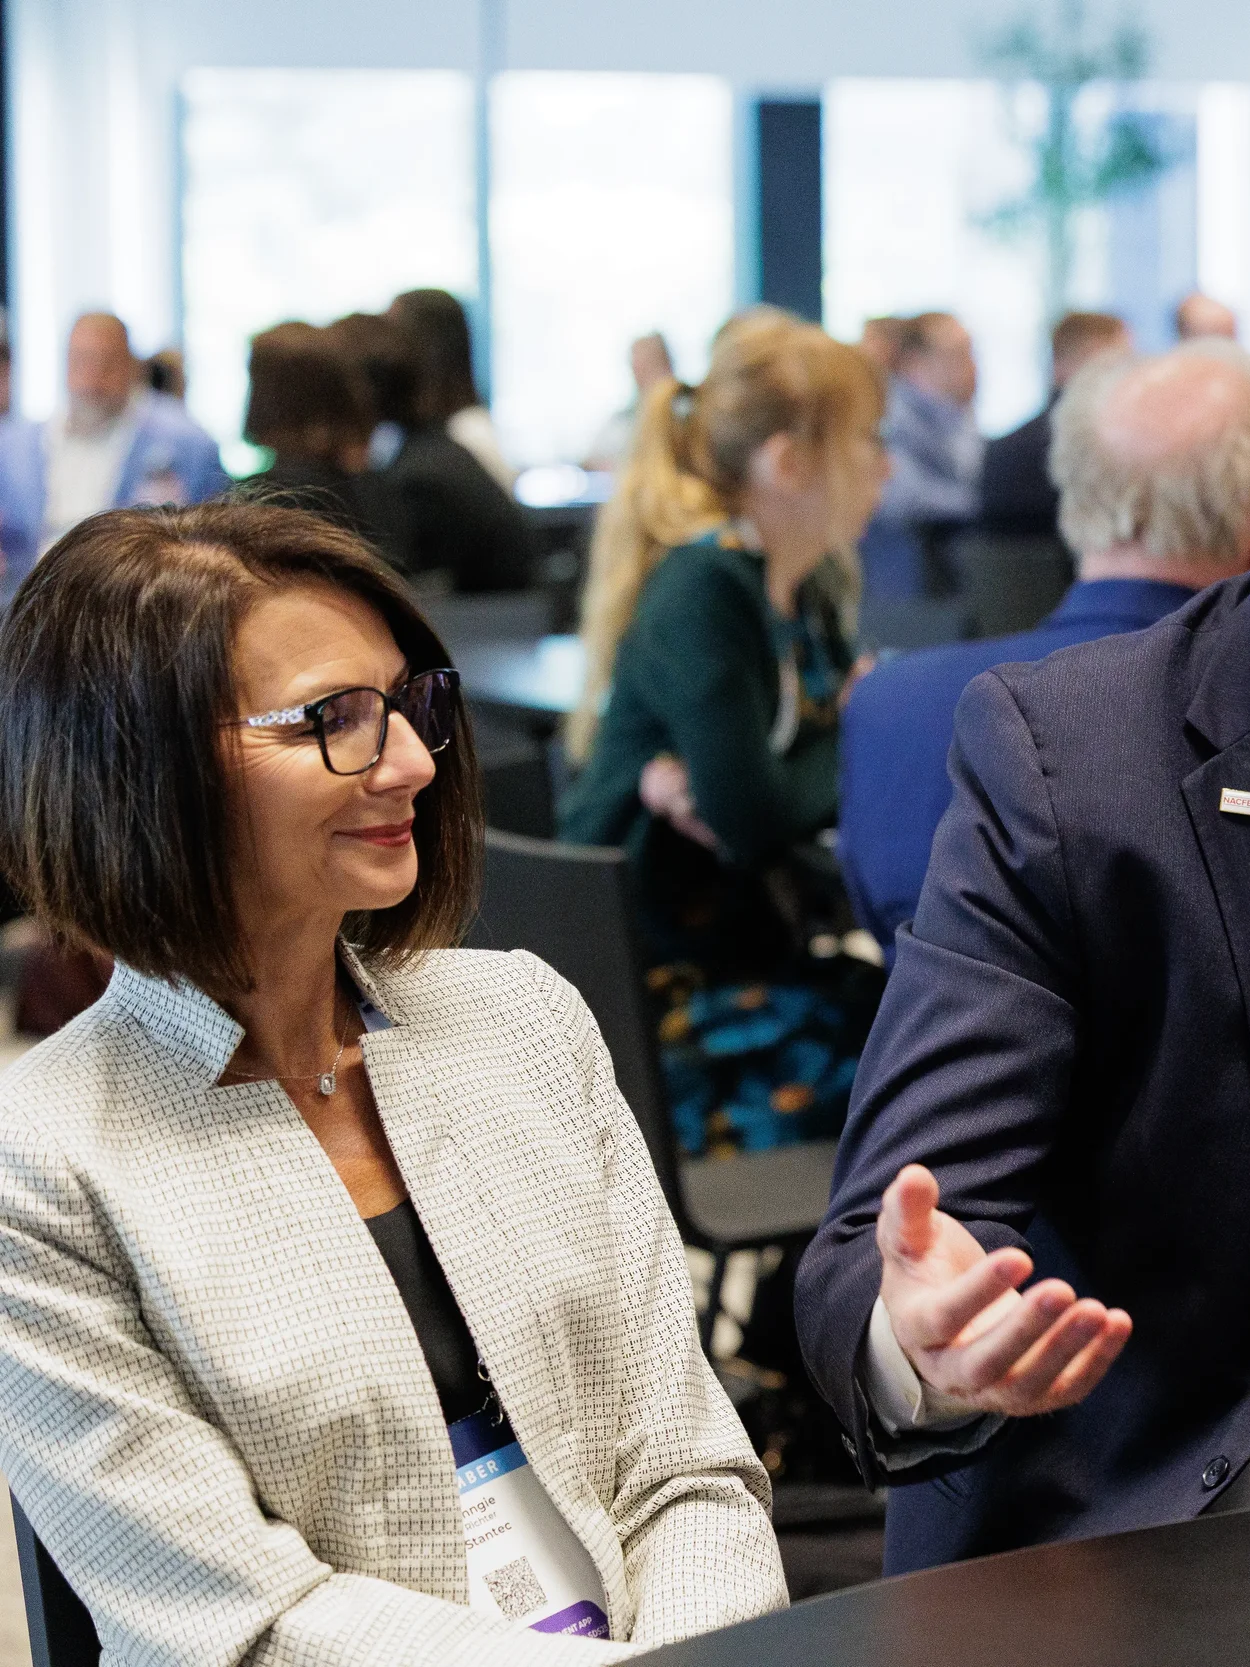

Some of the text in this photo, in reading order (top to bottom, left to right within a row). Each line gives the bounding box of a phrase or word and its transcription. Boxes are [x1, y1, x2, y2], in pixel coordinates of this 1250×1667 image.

[464, 1511, 497, 1531] Richter
[464, 1522, 512, 1550] Stantec
[578, 1616, 593, 1630] APP
